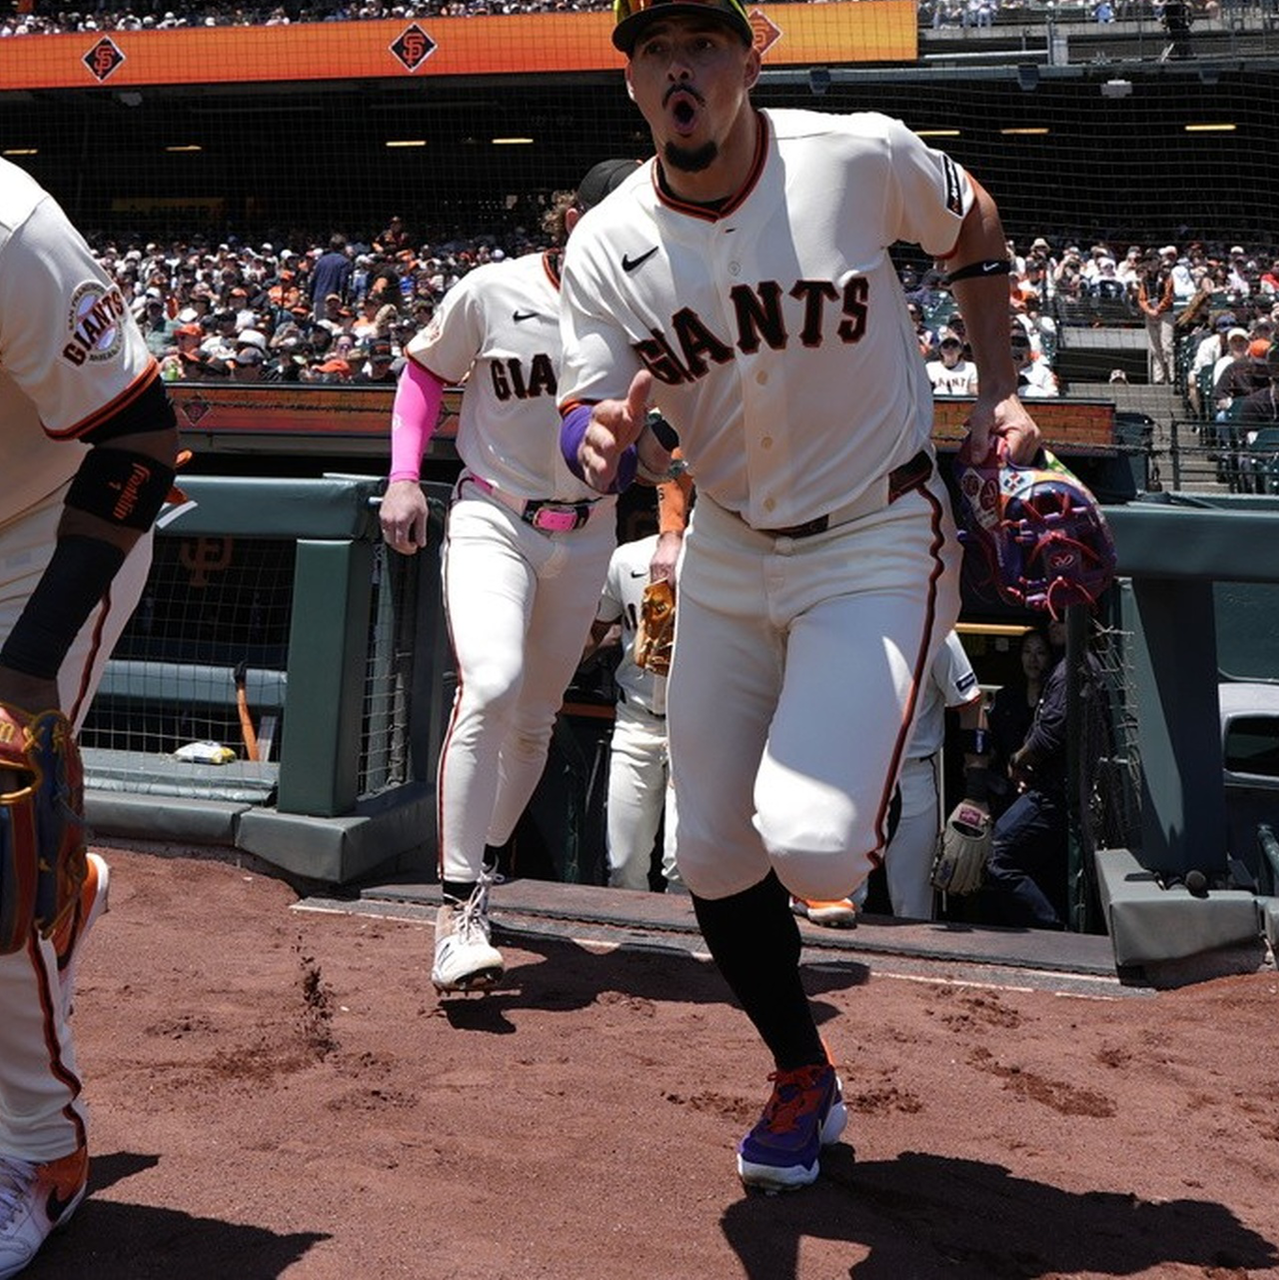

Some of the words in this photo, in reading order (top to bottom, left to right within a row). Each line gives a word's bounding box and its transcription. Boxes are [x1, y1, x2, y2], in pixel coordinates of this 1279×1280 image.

[63, 290, 124, 367] GIANTS
[631, 276, 869, 385] GIANTS
[489, 352, 558, 402] GIA
